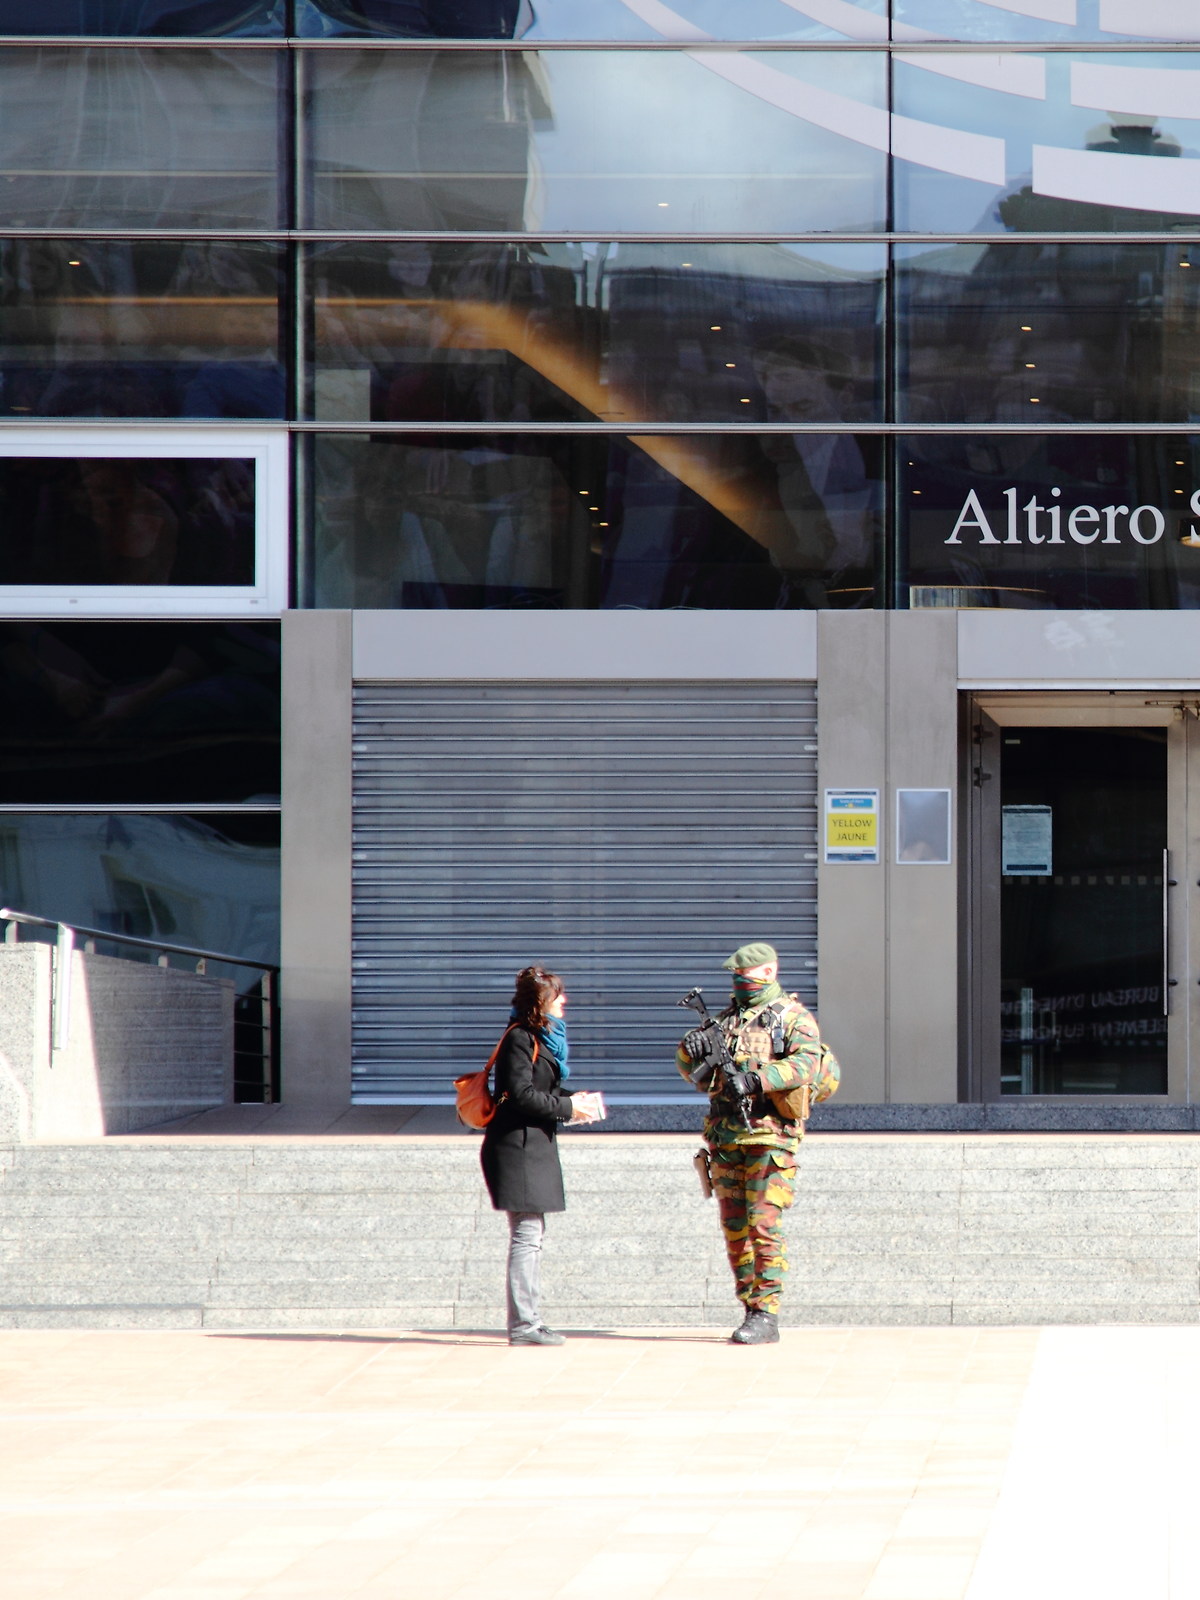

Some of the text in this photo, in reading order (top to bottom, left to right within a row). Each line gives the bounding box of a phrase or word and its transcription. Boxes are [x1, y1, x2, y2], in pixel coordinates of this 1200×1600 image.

[943, 486, 1165, 545] Altiero
[831, 818, 873, 828] YELLOW
[836, 832, 869, 841] JAUNE
